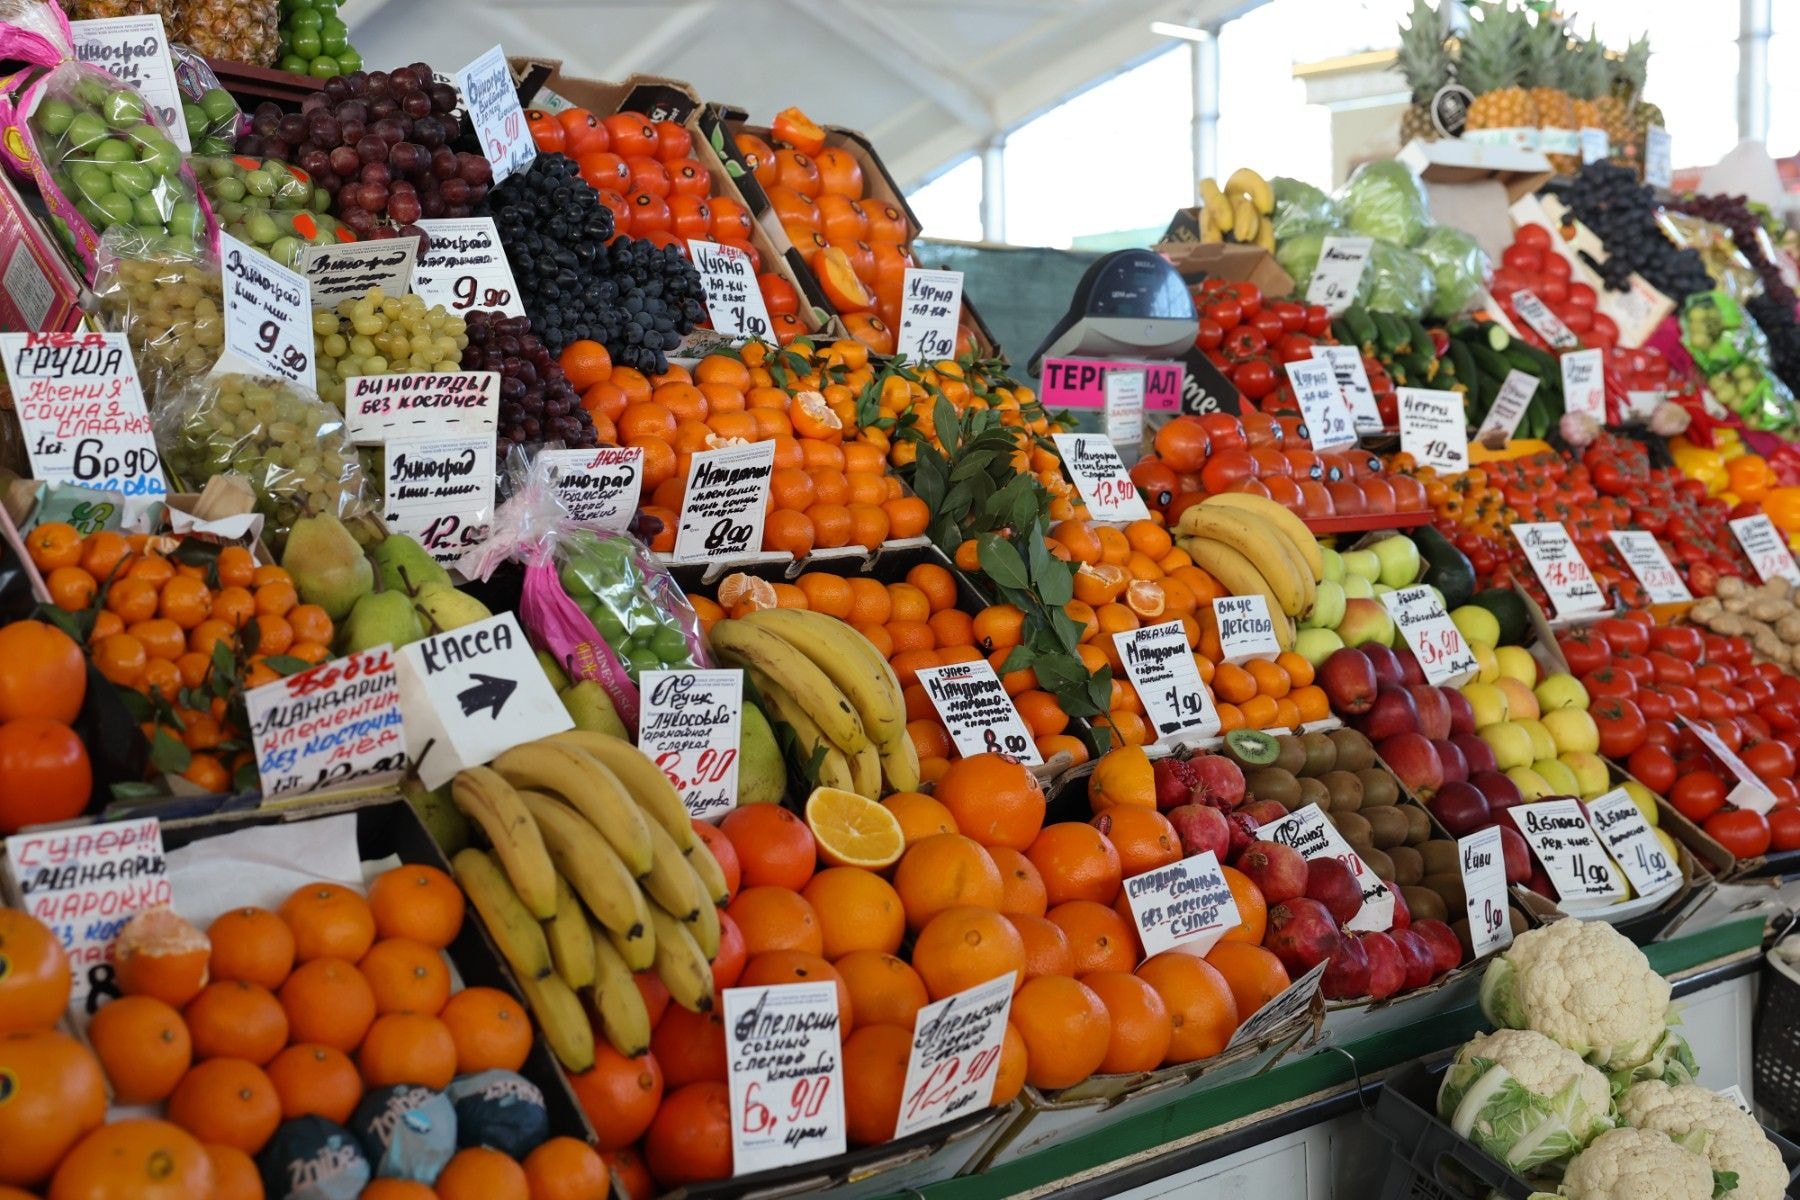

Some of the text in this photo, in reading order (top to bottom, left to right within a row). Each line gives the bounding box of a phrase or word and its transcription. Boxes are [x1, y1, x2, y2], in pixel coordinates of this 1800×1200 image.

[74, 37, 158, 63] иноград
[697, 248, 744, 275] ХУРМА
[452, 276, 511, 310] 9.90
[909, 278, 953, 302] ХУРМА
[16, 346, 122, 378] ГРУША
[356, 375, 491, 397] ВИНОГРАДЫ
[55, 412, 153, 439] СЛАДКАЯ
[390, 448, 476, 483] Виноград
[1222, 619, 1271, 639] ДЕТСТВА
[420, 623, 513, 675] КАССА
[251, 671, 397, 736] МАНДАРИН
[1527, 811, 1585, 834] Яблоко
[1464, 845, 1491, 873] Киви
[35, 880, 172, 921] МАРОККО
[1170, 907, 1219, 935] СУПЕР
[735, 989, 838, 1042] Апельсин
[914, 997, 1010, 1049] Апельсин
[907, 1044, 1000, 1119] 12,90
[743, 1075, 830, 1136] 6,90
